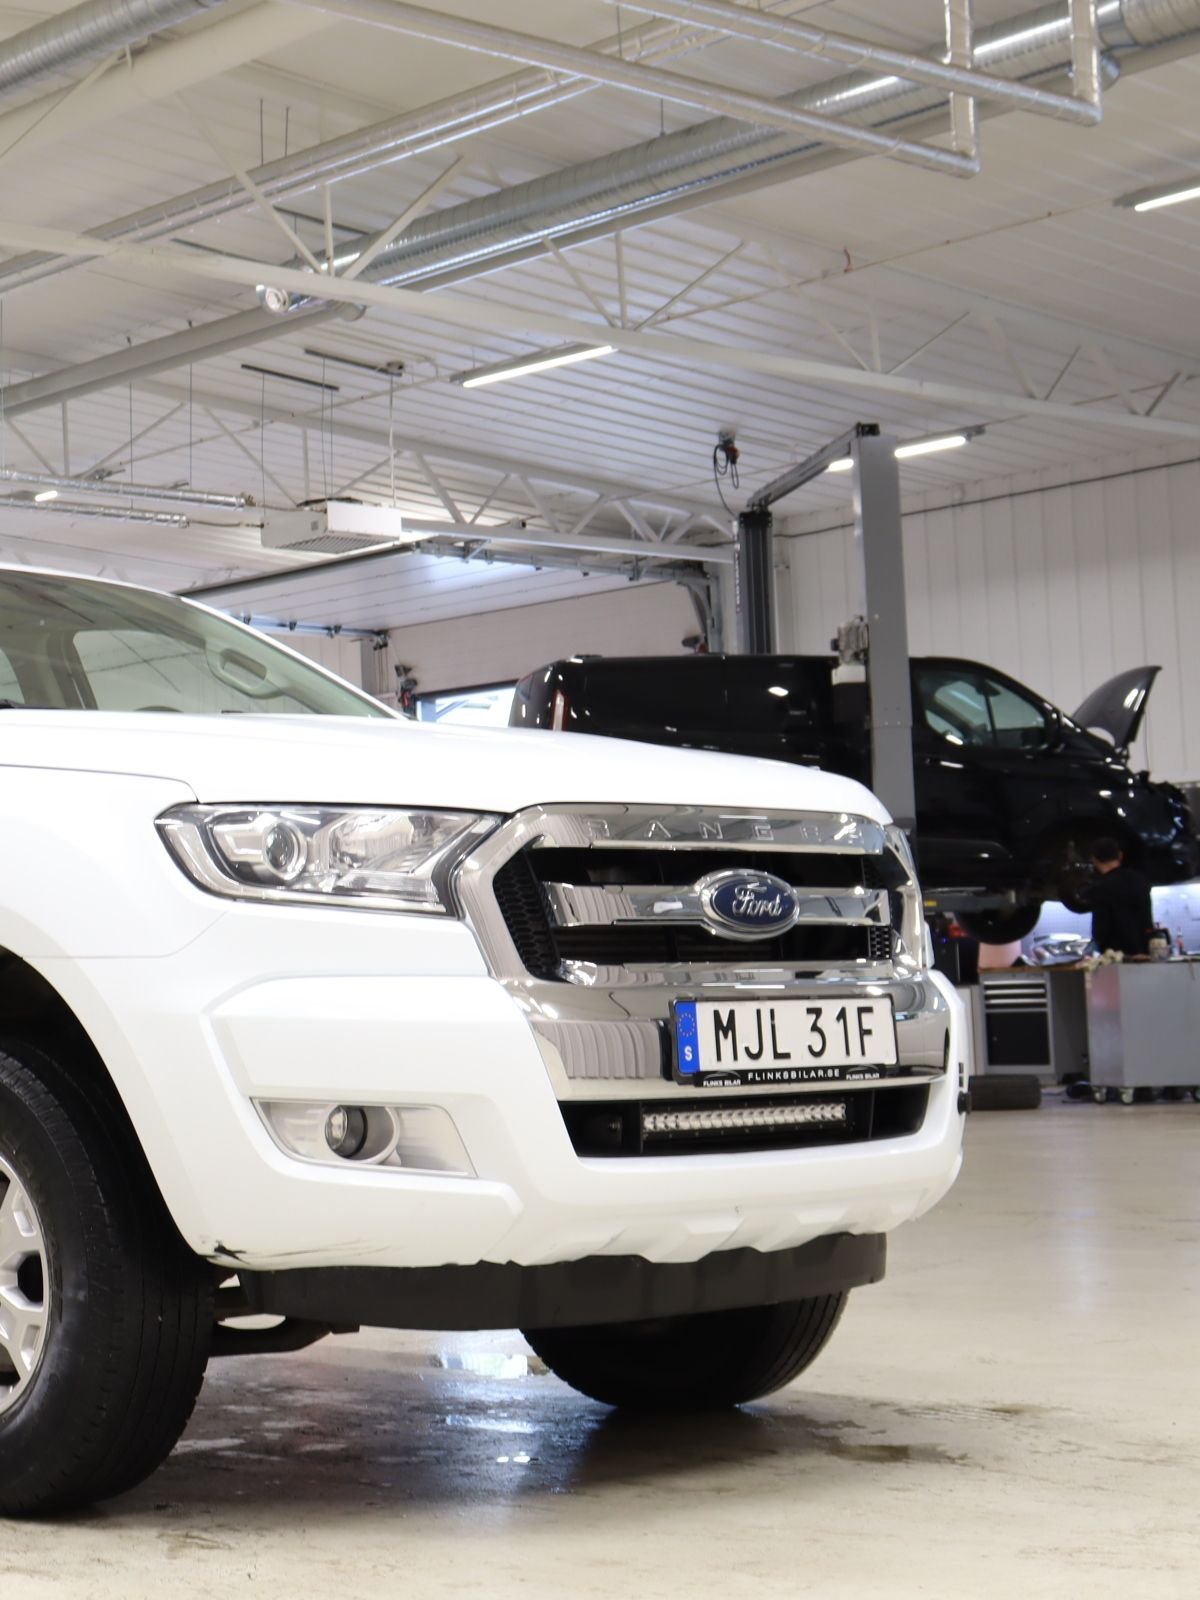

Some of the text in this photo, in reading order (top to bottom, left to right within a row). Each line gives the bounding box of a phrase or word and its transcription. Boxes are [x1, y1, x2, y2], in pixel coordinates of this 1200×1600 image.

[586, 819, 862, 842] RANG
[732, 882, 782, 916] Ford
[713, 1006, 874, 1062] MJL 31F
[684, 1045, 694, 1061] S
[748, 1068, 840, 1081] FLINKSBILAR.SE
